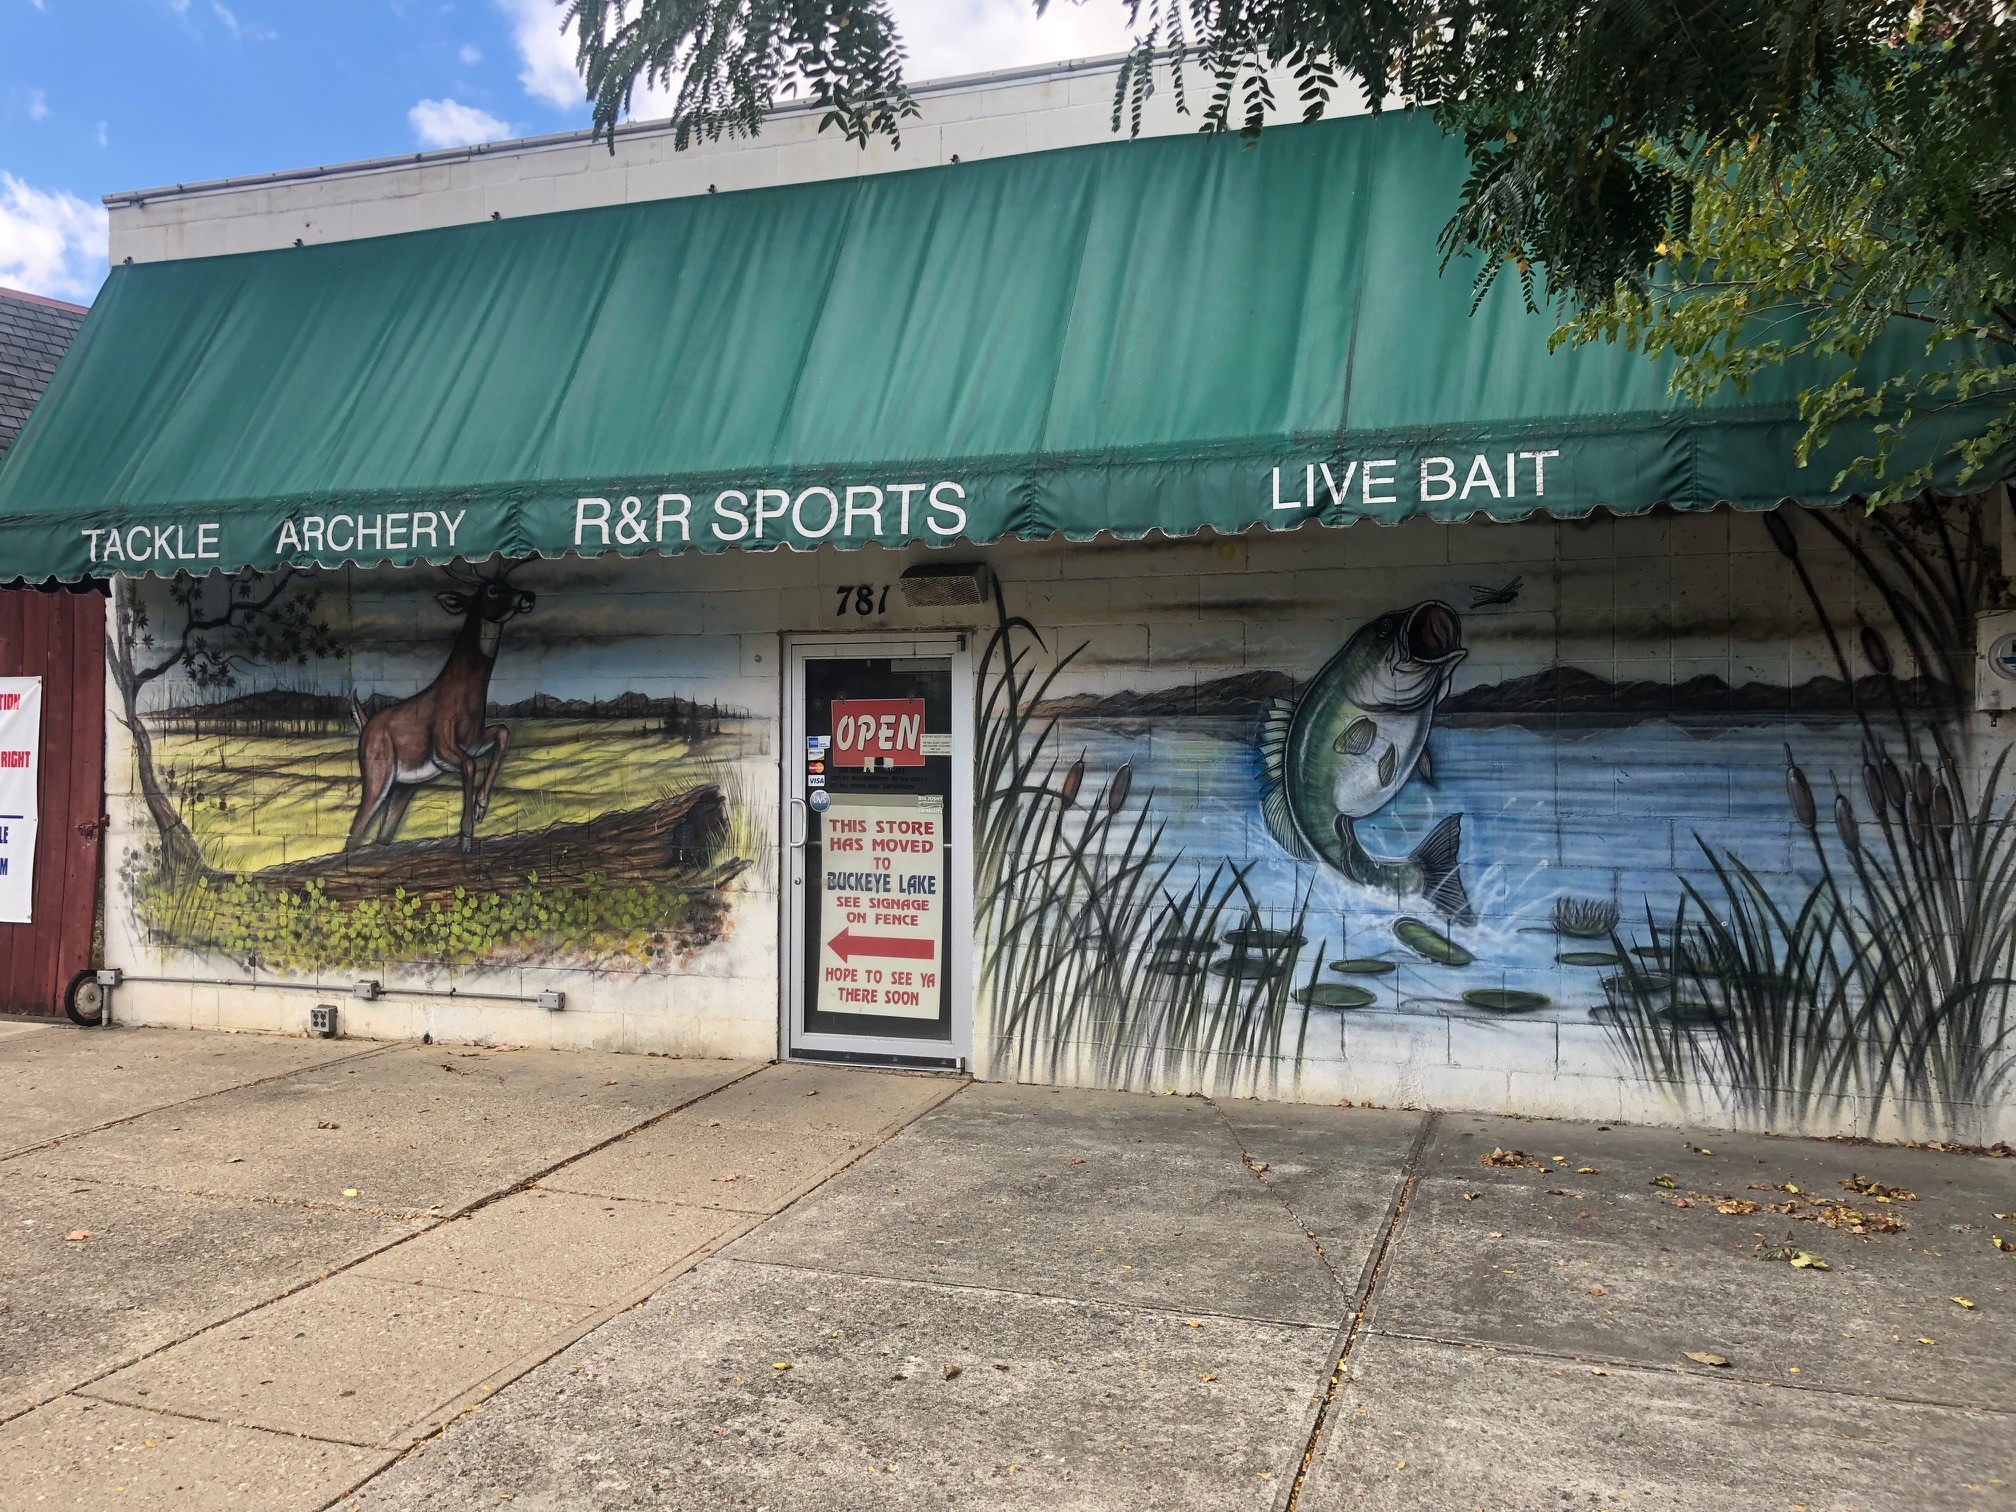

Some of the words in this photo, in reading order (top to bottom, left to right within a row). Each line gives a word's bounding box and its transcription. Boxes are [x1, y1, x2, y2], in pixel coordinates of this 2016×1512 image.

[1272, 459, 1397, 510] LIVE
[1420, 450, 1559, 502] BAIT
[574, 493, 692, 545] R&R
[711, 481, 967, 541] SPORTS
[82, 523, 219, 562] TACKLE
[275, 509, 466, 554] ARCHERY
[836, 585, 890, 616] 781
[836, 714, 921, 751] OPEN
[1, 751, 31, 767] RIGHT
[829, 819, 867, 834] THIS
[876, 820, 935, 836] STORE
[829, 837, 864, 852] HAS
[872, 838, 934, 854] MOVED
[873, 856, 891, 871] TO
[827, 871, 891, 893] BUCKEYE
[899, 875, 936, 895] LAKE
[836, 896, 861, 908] SEE
[869, 897, 930, 911] SIGNAGE
[846, 911, 867, 924] ON
[874, 913, 919, 926] FENCE
[825, 967, 858, 983] HOPE
[865, 969, 882, 984] TO
[891, 971, 912, 986] SEE
[920, 973, 936, 988] YA
[837, 987, 878, 1004] THERE
[885, 989, 919, 1006] SOON
